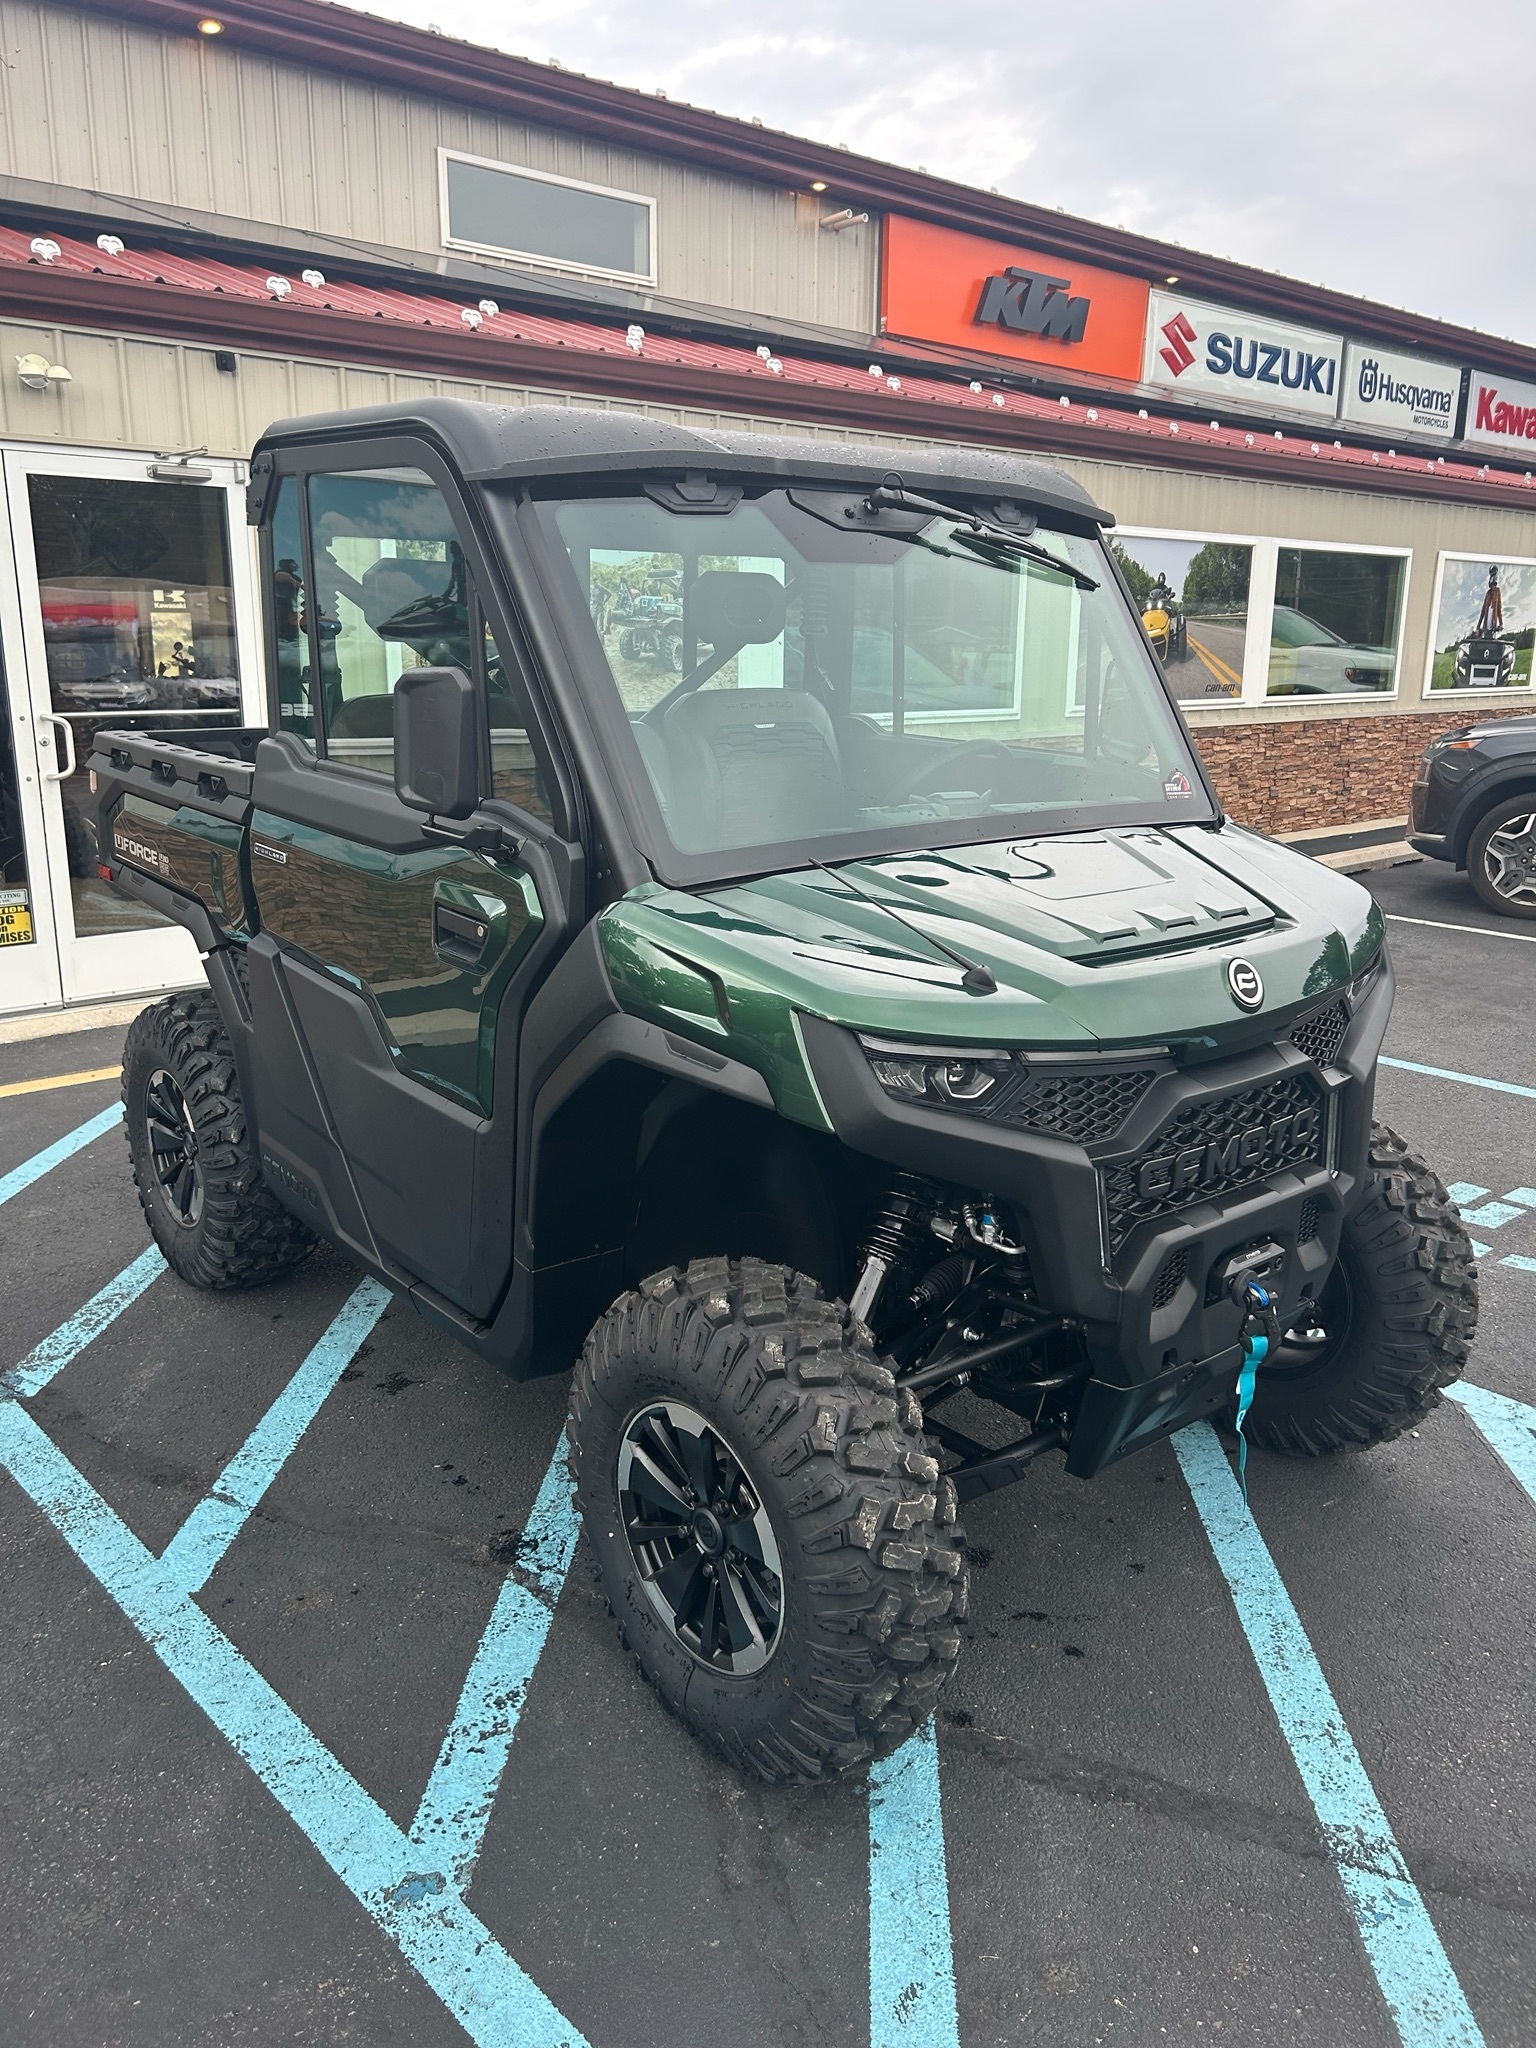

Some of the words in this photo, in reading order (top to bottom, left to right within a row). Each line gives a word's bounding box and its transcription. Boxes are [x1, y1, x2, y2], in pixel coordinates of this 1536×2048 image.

[974, 266, 1091, 343] KTM
[1206, 332, 1335, 396] SUZUKI
[1378, 373, 1452, 413] Husqvarna
[1413, 415, 1449, 429] MOTORCYCLES
[1205, 683, 1235, 692] can-am
[255, 846, 284, 861] HIGHLAND
[1139, 1107, 1315, 1199] CFMOTO
